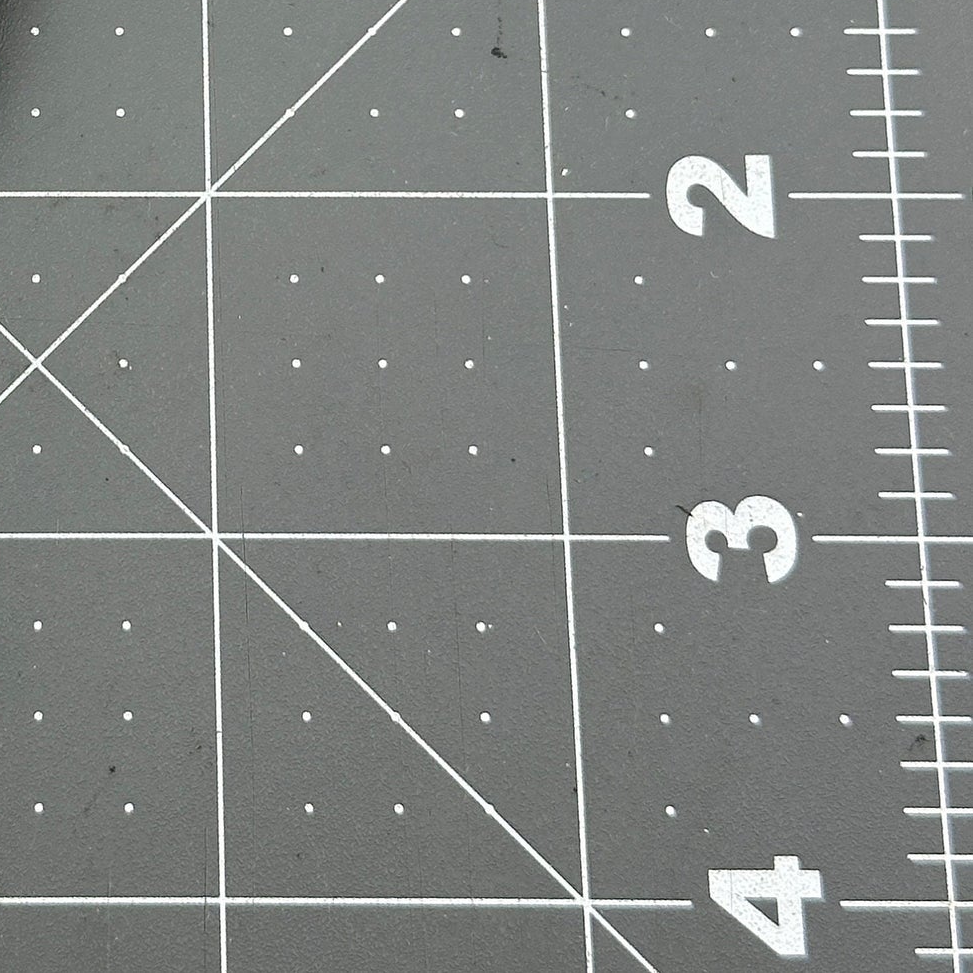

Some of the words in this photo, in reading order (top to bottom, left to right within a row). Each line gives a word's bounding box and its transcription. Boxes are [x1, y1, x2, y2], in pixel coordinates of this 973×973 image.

[666, 153, 777, 239] 2
[685, 494, 798, 584] 3
[707, 855, 825, 957] 4
